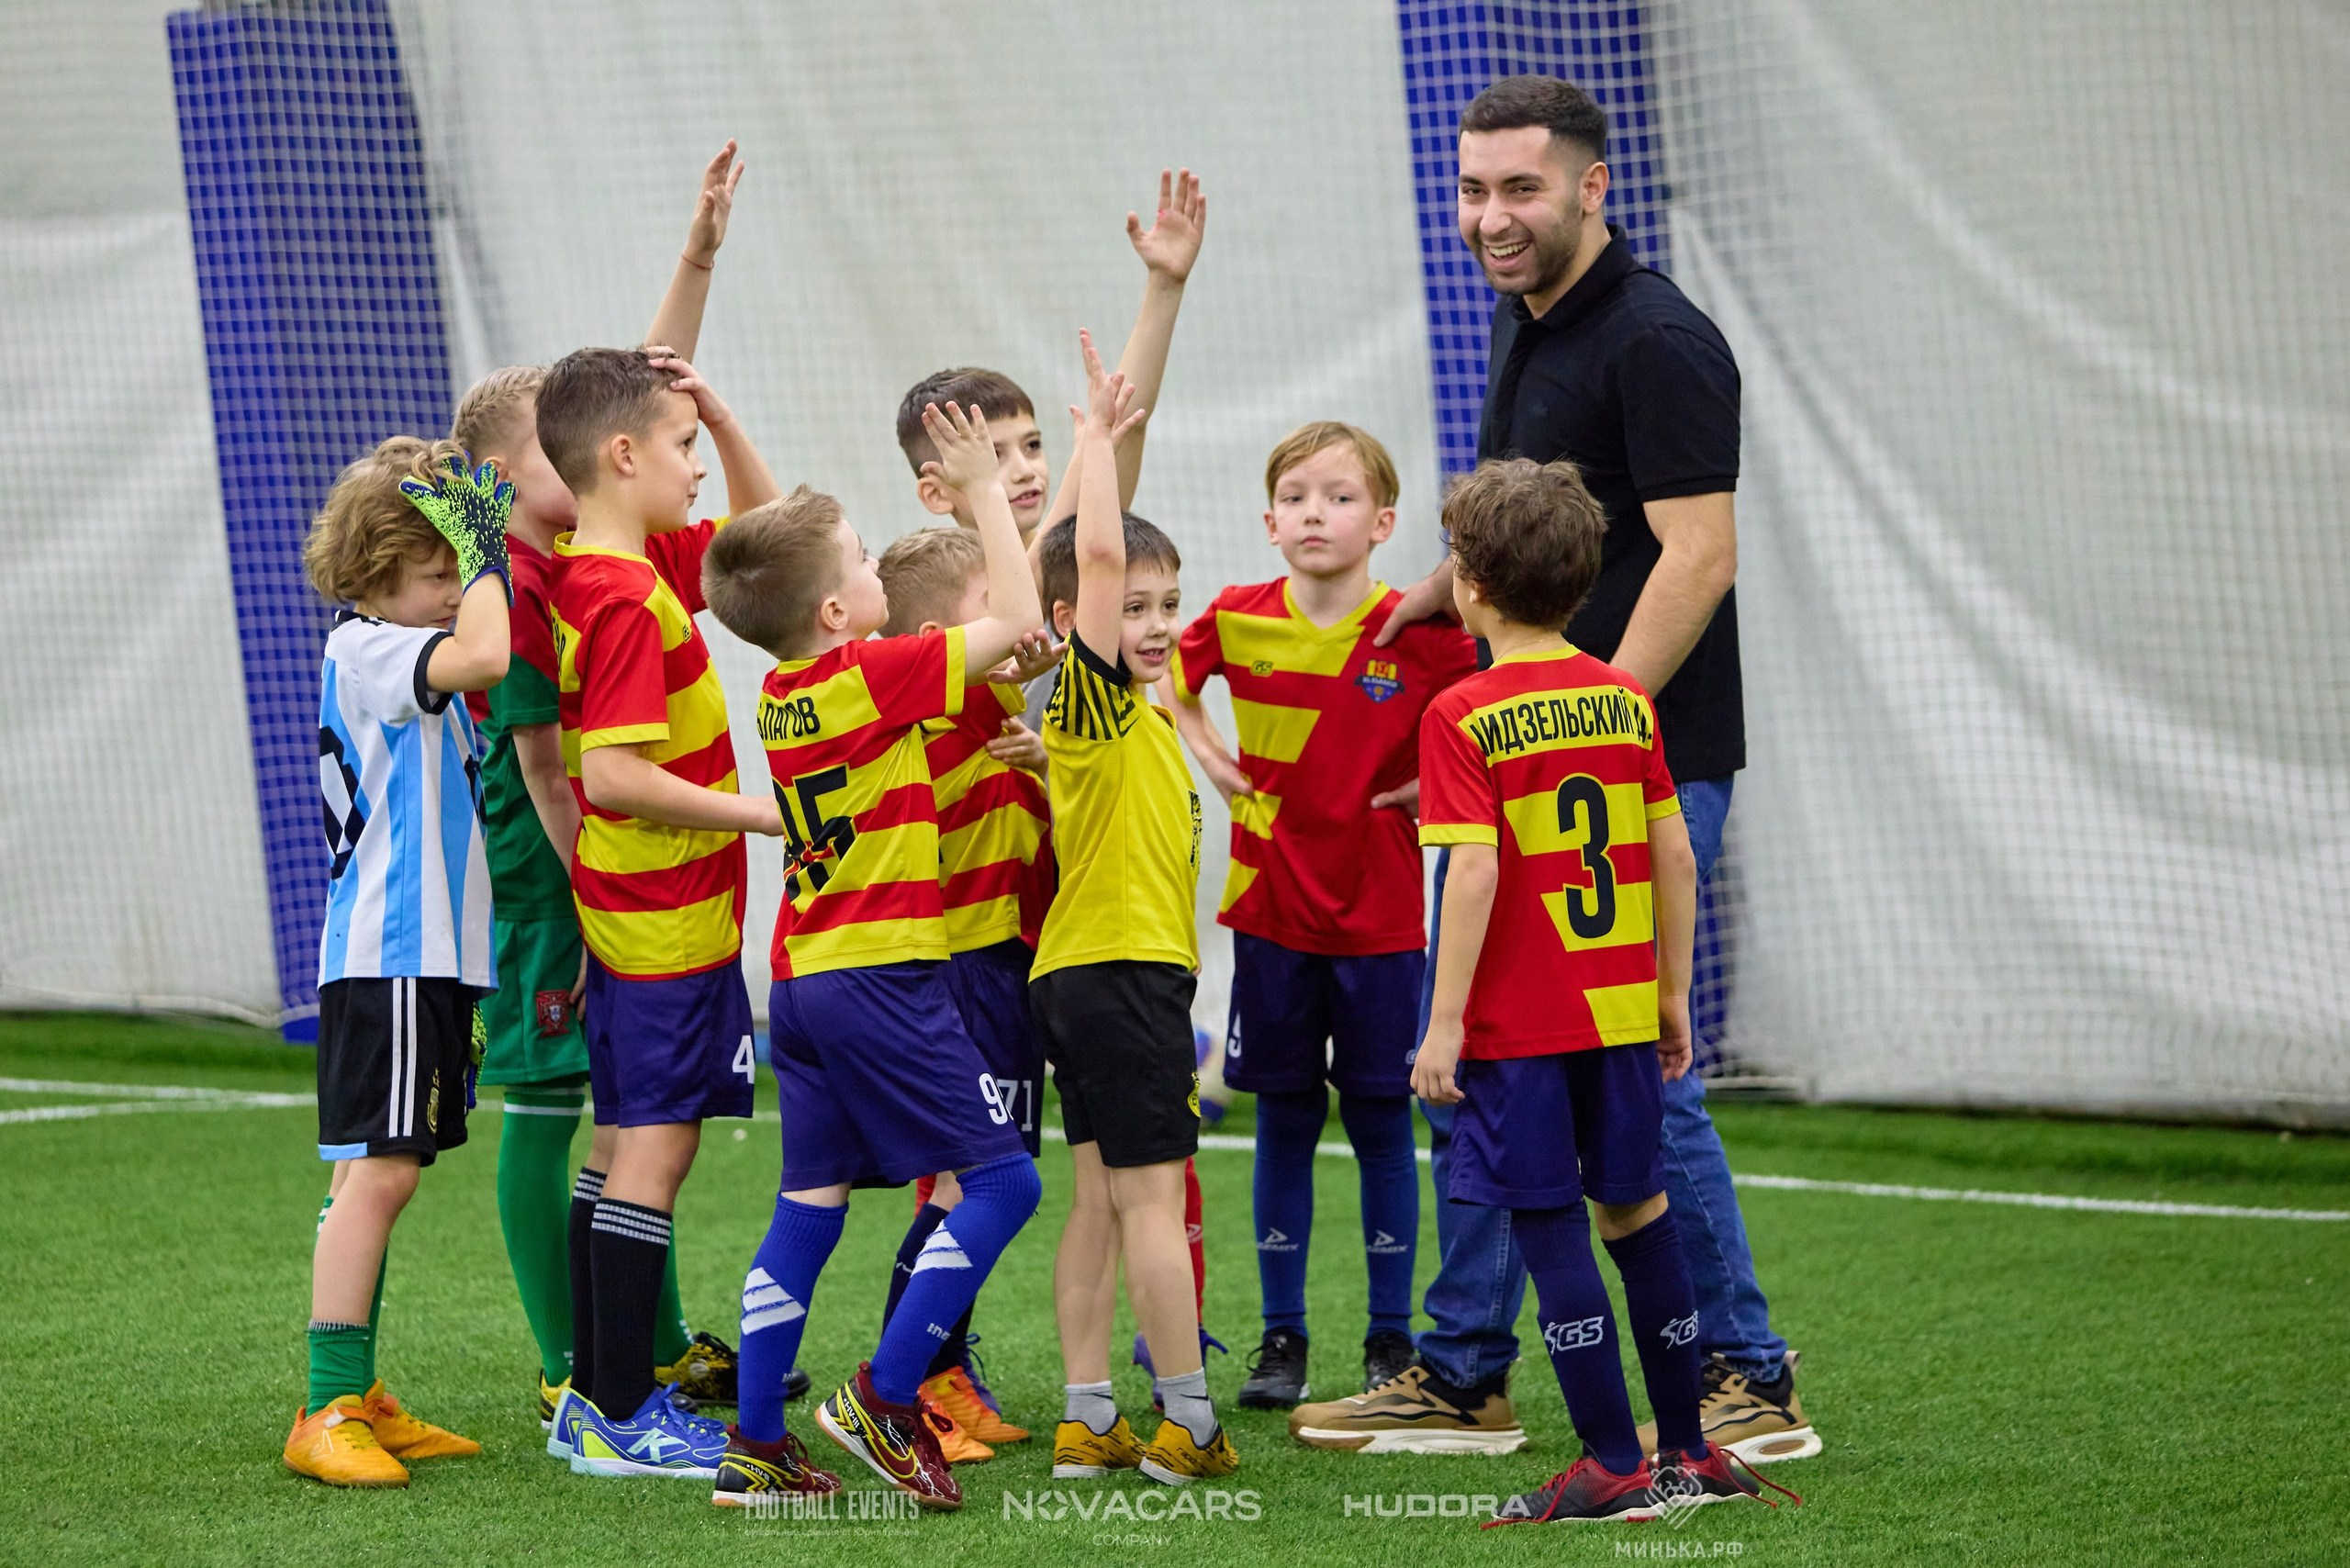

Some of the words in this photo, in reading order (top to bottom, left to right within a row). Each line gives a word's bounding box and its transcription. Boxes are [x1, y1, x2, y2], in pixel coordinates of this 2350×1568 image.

[1557, 776, 1616, 939] 3
[732, 1035, 755, 1084] 4
[979, 1072, 1014, 1126] 9
